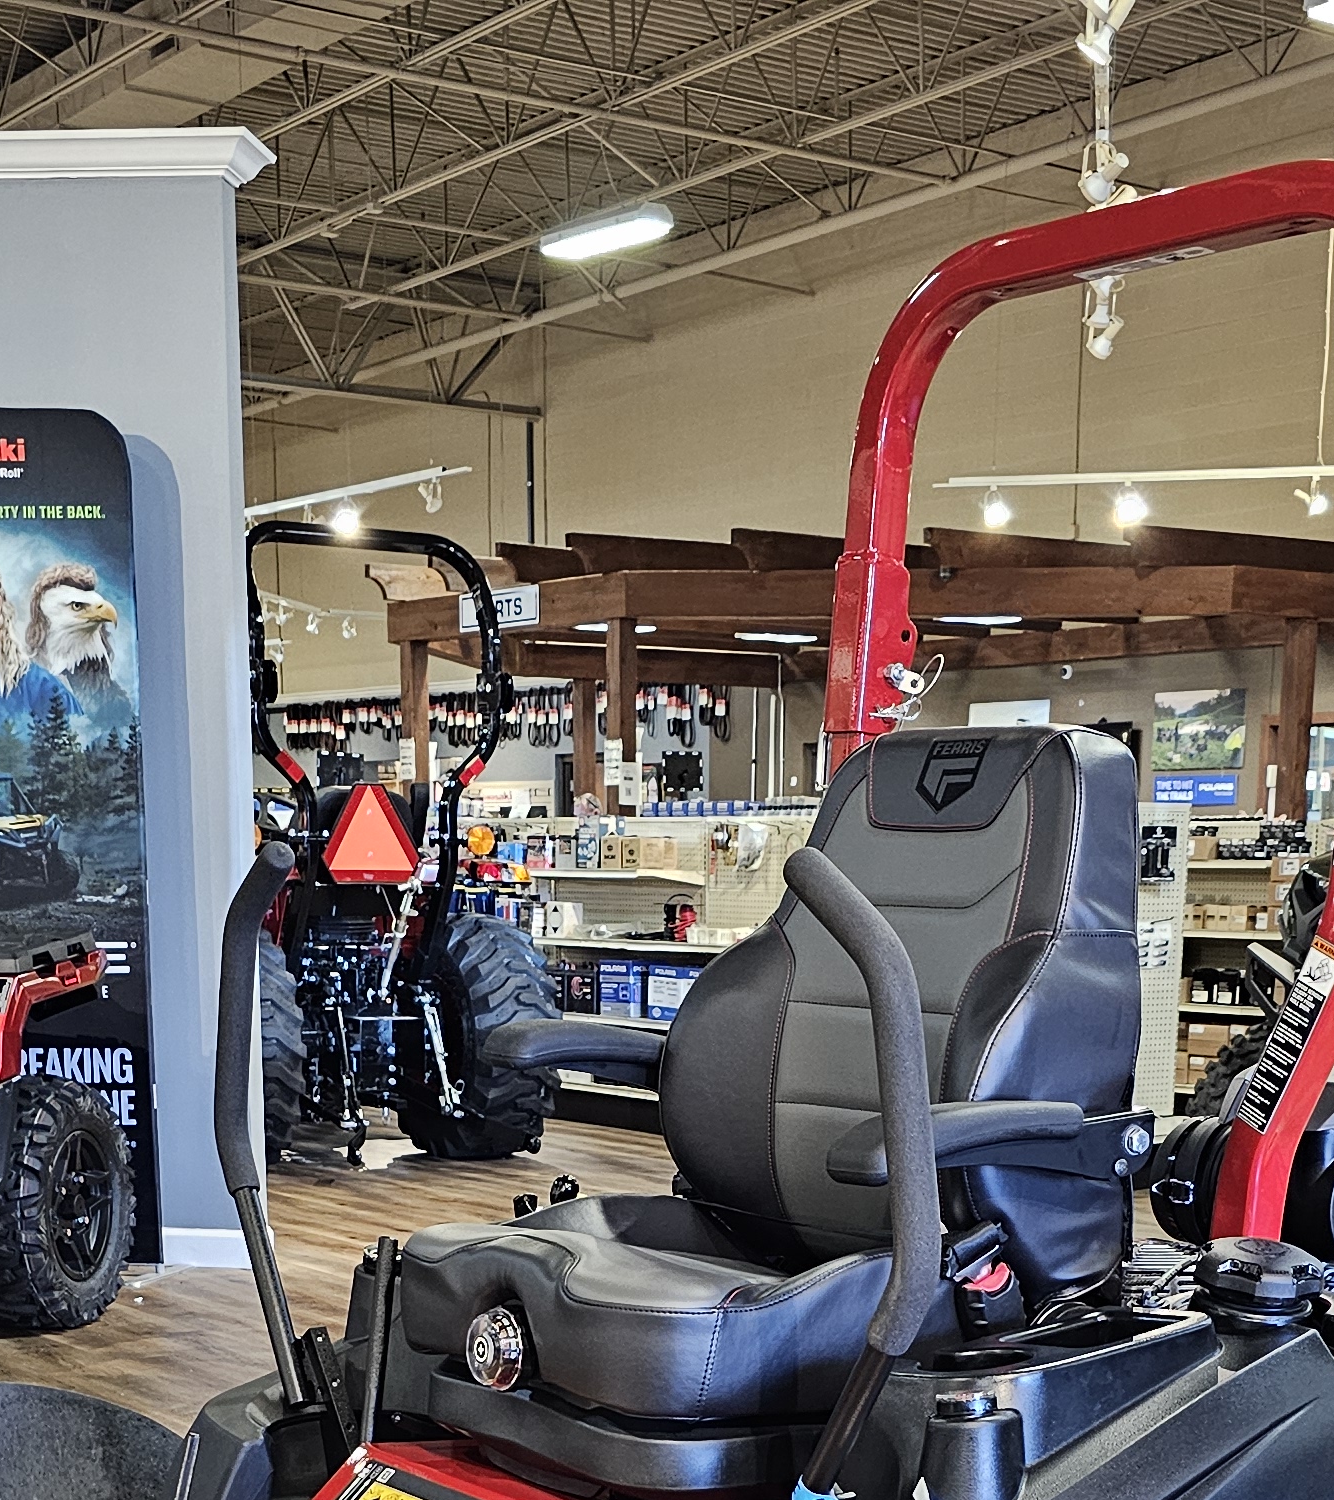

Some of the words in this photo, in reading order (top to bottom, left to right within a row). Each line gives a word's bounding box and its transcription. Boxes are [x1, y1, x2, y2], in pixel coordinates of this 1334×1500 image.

[22, 505, 36, 518] IN
[39, 505, 64, 518] THE
[67, 505, 106, 519] BACK.
[496, 597, 523, 617] RTS
[932, 740, 987, 756] FERRIS
